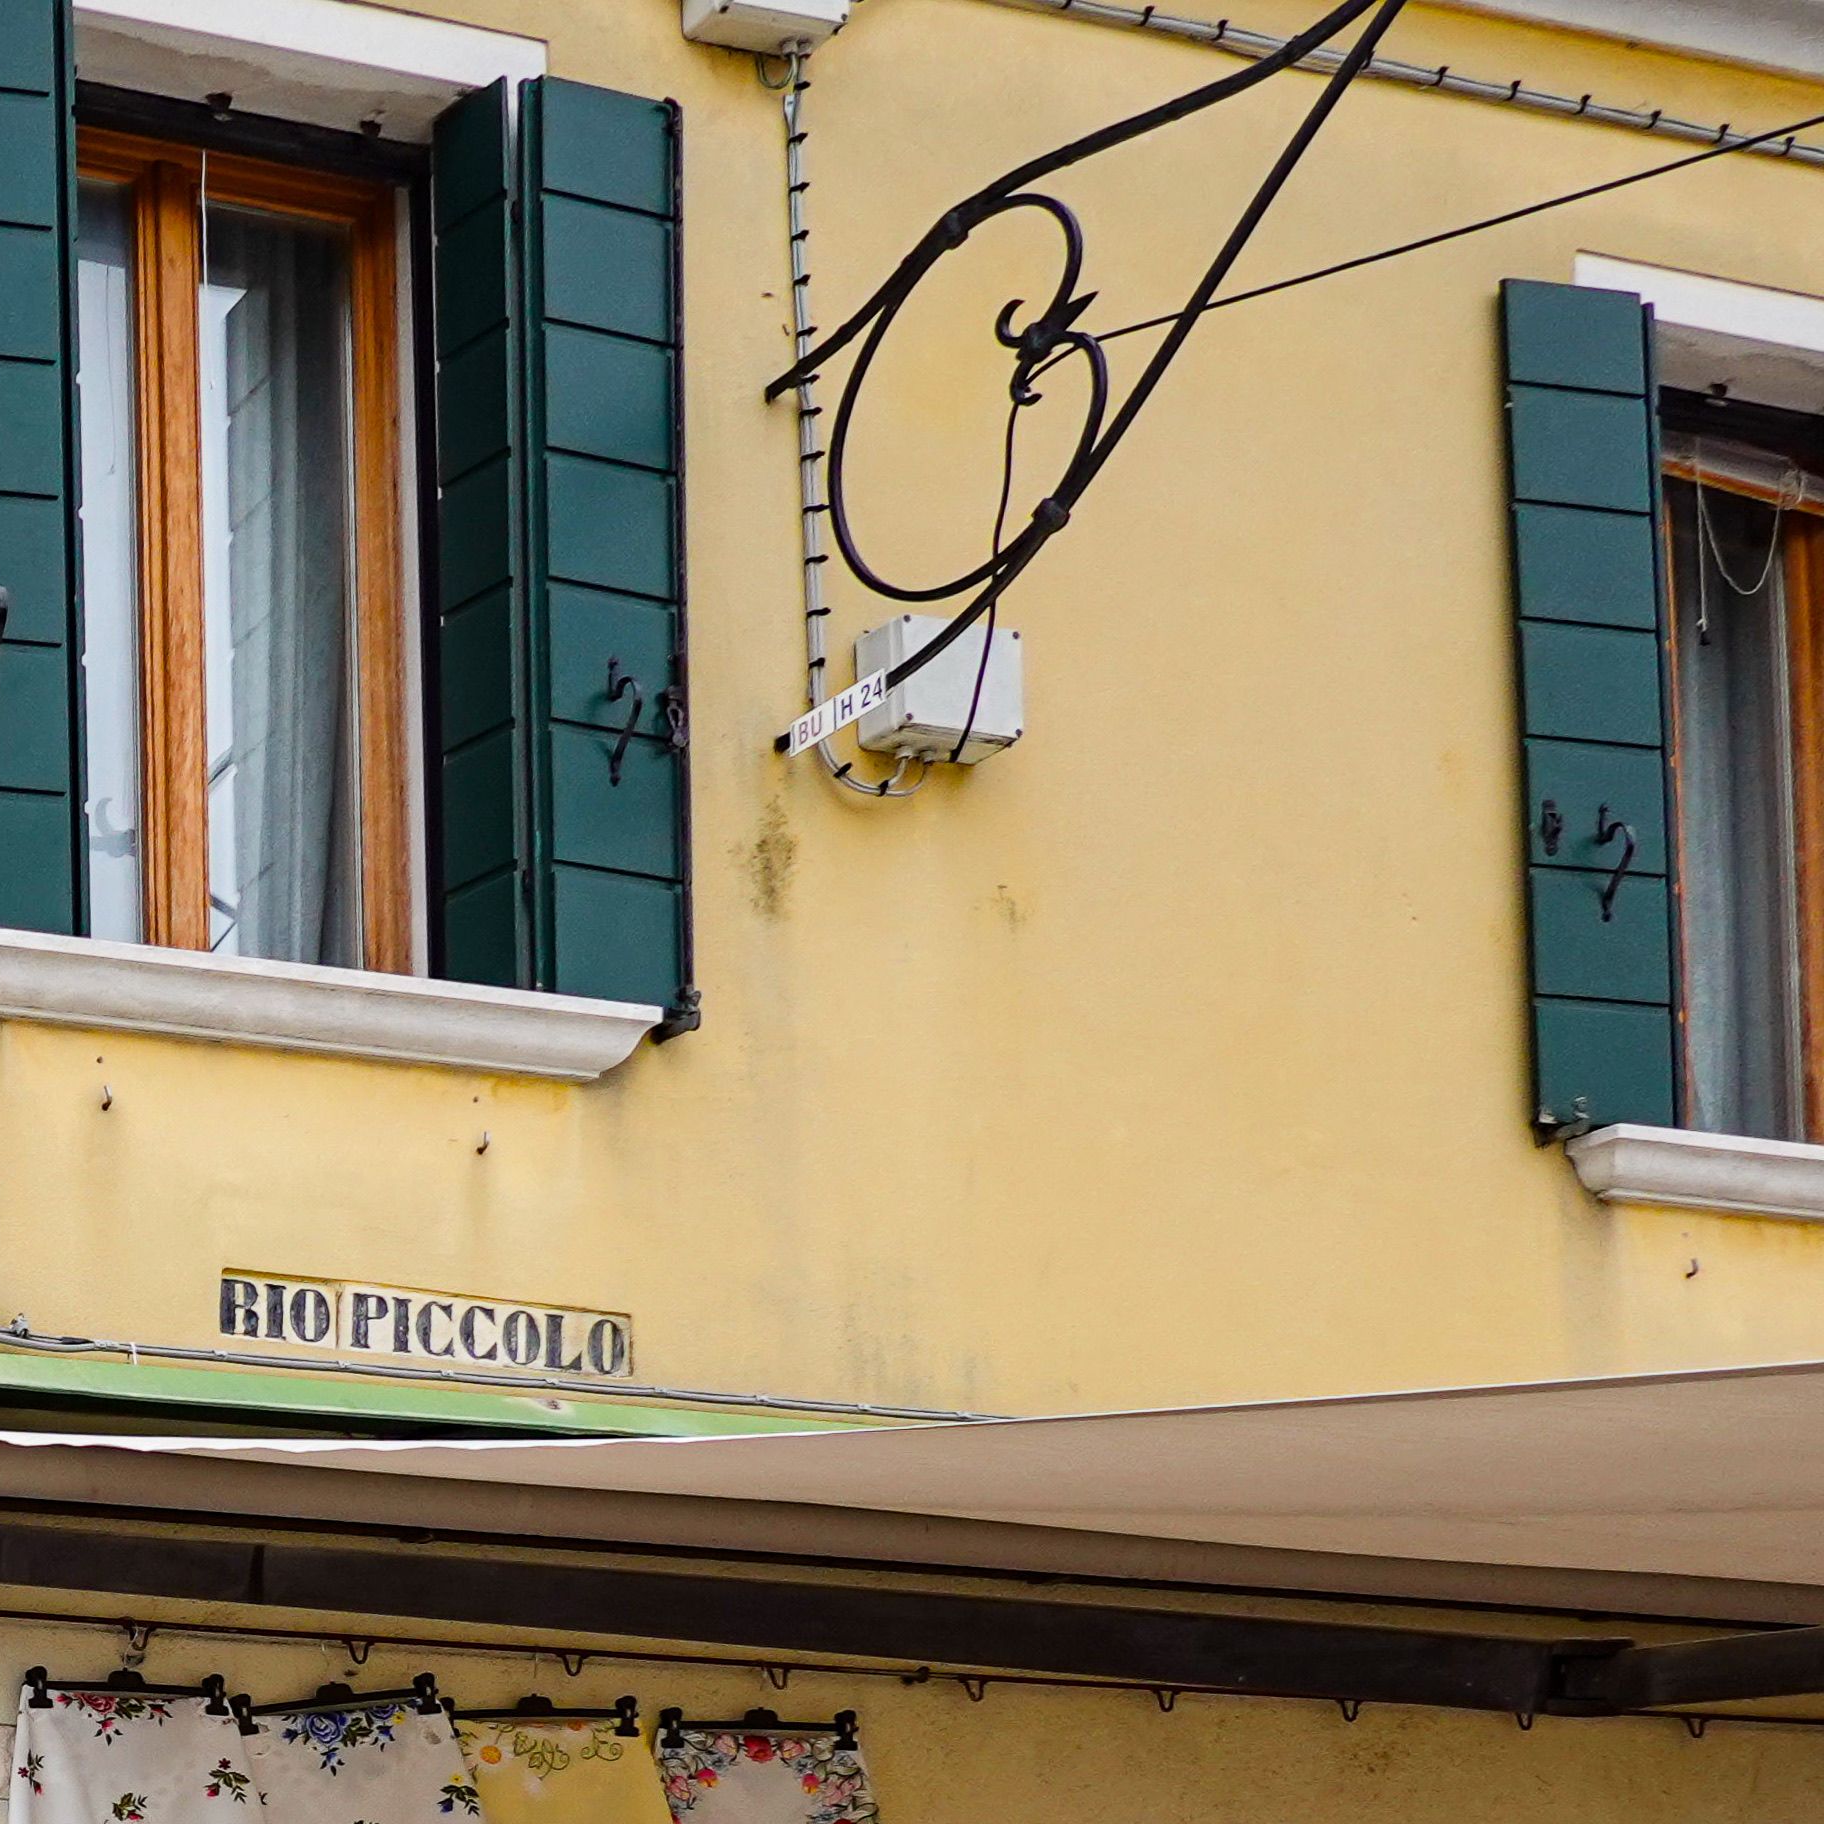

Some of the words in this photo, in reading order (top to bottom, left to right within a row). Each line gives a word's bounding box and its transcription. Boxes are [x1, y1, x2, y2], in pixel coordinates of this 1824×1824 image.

[798, 711, 822, 745] BU
[840, 694, 853, 720] H
[860, 676, 883, 709] 24
[219, 1278, 330, 1343] RIO
[350, 1292, 625, 1375] PICCOLO
